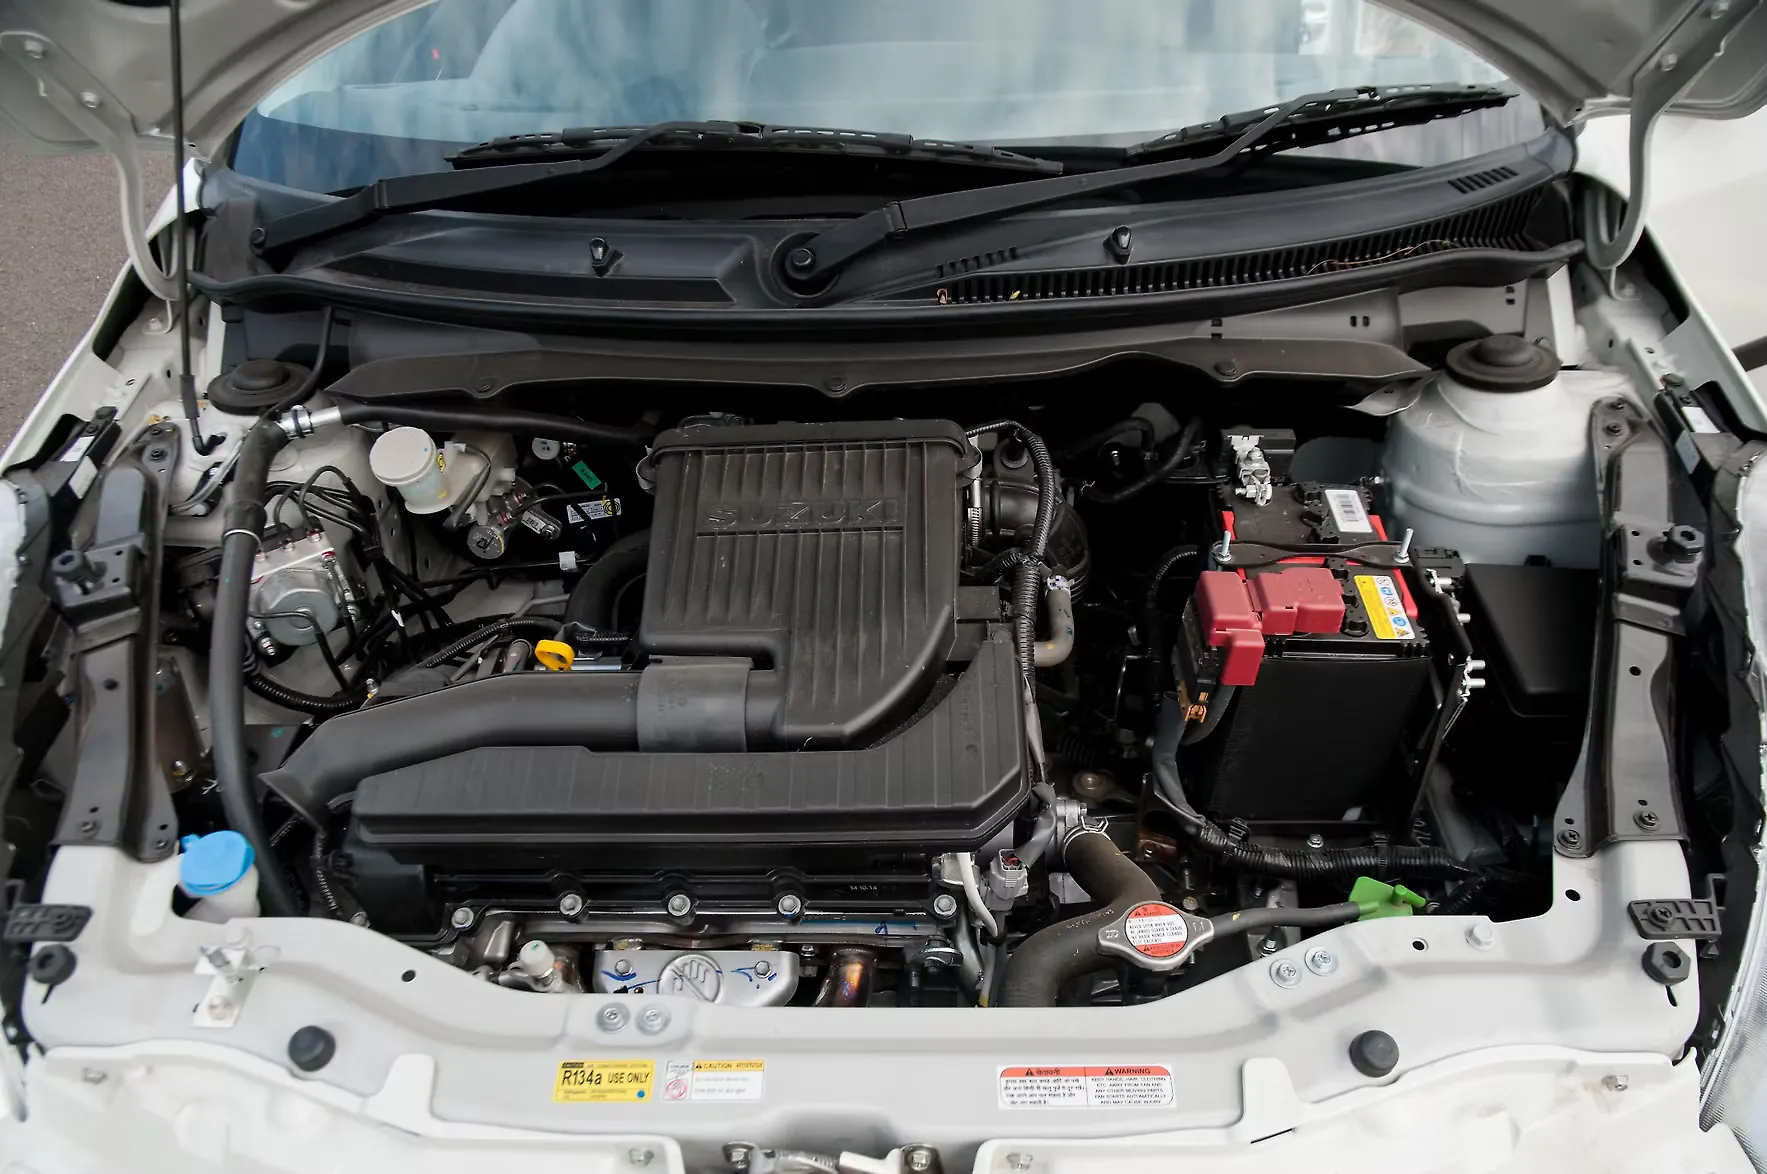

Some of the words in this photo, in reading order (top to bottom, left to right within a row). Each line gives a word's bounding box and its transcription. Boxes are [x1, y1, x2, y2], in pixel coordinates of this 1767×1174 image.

[704, 501, 898, 529] SUZUKI
[562, 1070, 602, 1086] R134a
[608, 1072, 625, 1084] USE
[627, 1072, 649, 1084] ONLY
